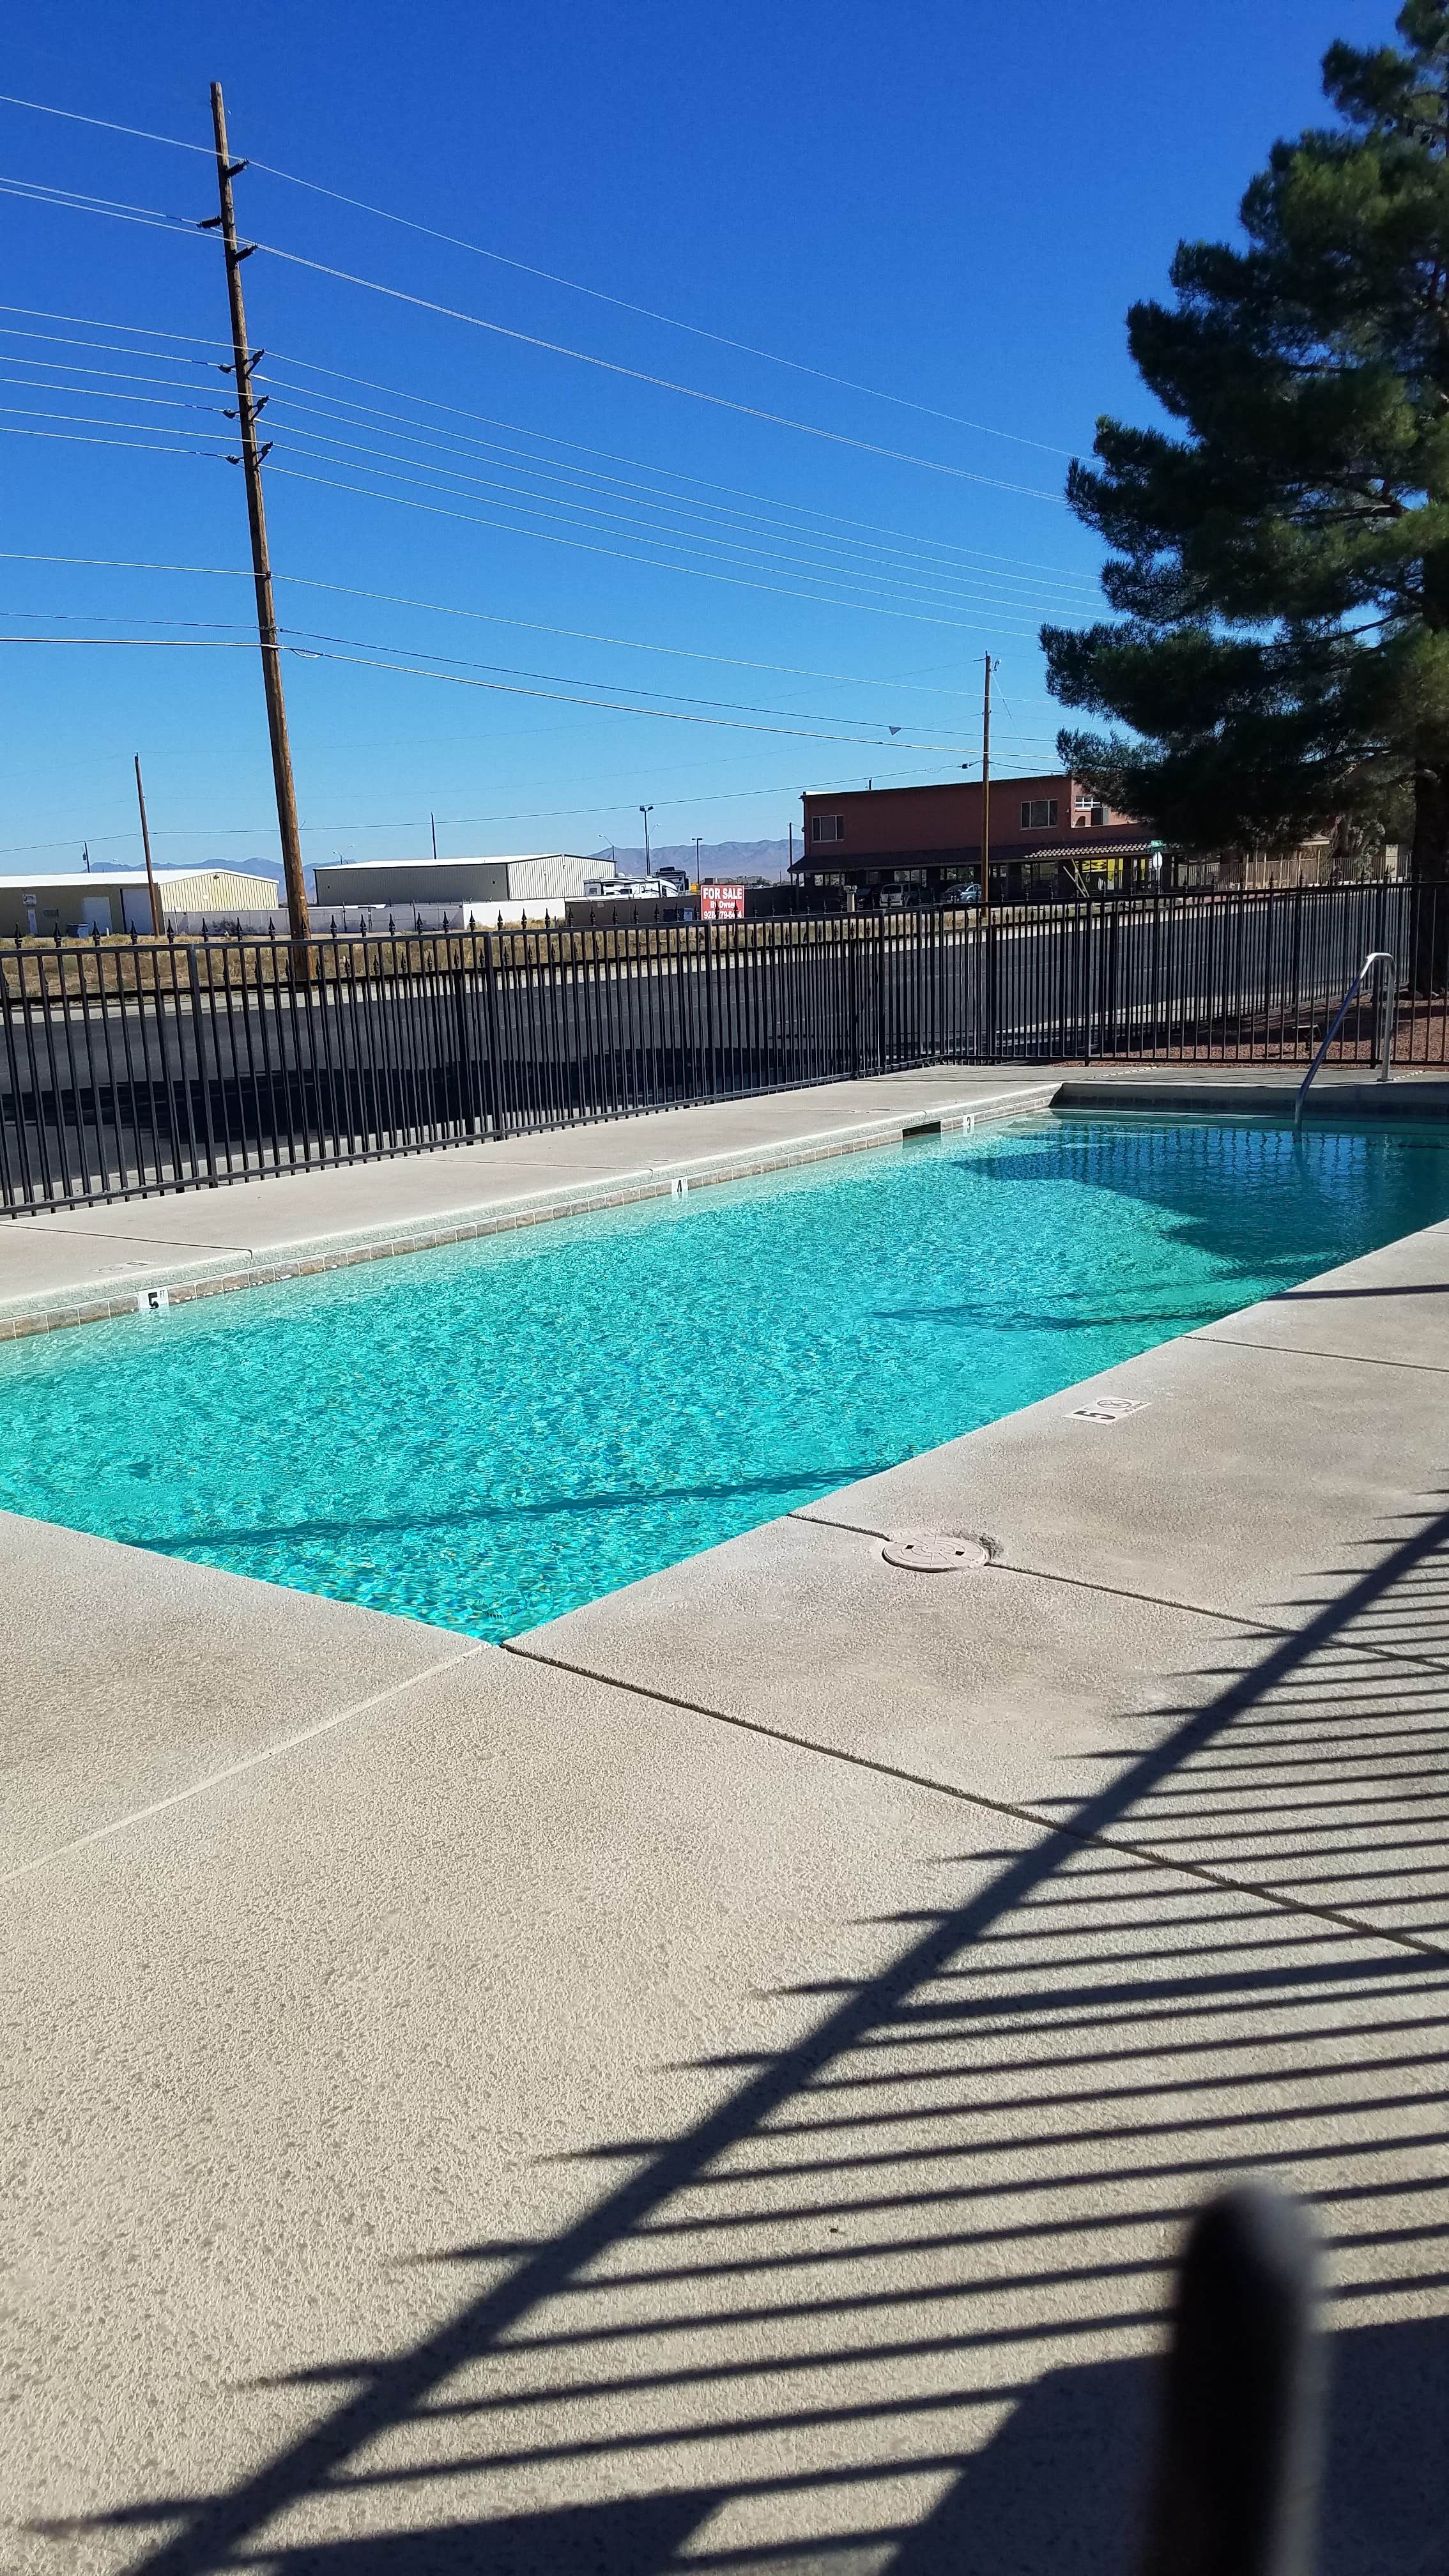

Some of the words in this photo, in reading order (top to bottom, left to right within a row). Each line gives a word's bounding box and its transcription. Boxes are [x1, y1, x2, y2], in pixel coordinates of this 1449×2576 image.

[703, 887, 721, 900] FOR
[722, 887, 742, 900] SALE
[148, 1291, 159, 1310] 5
